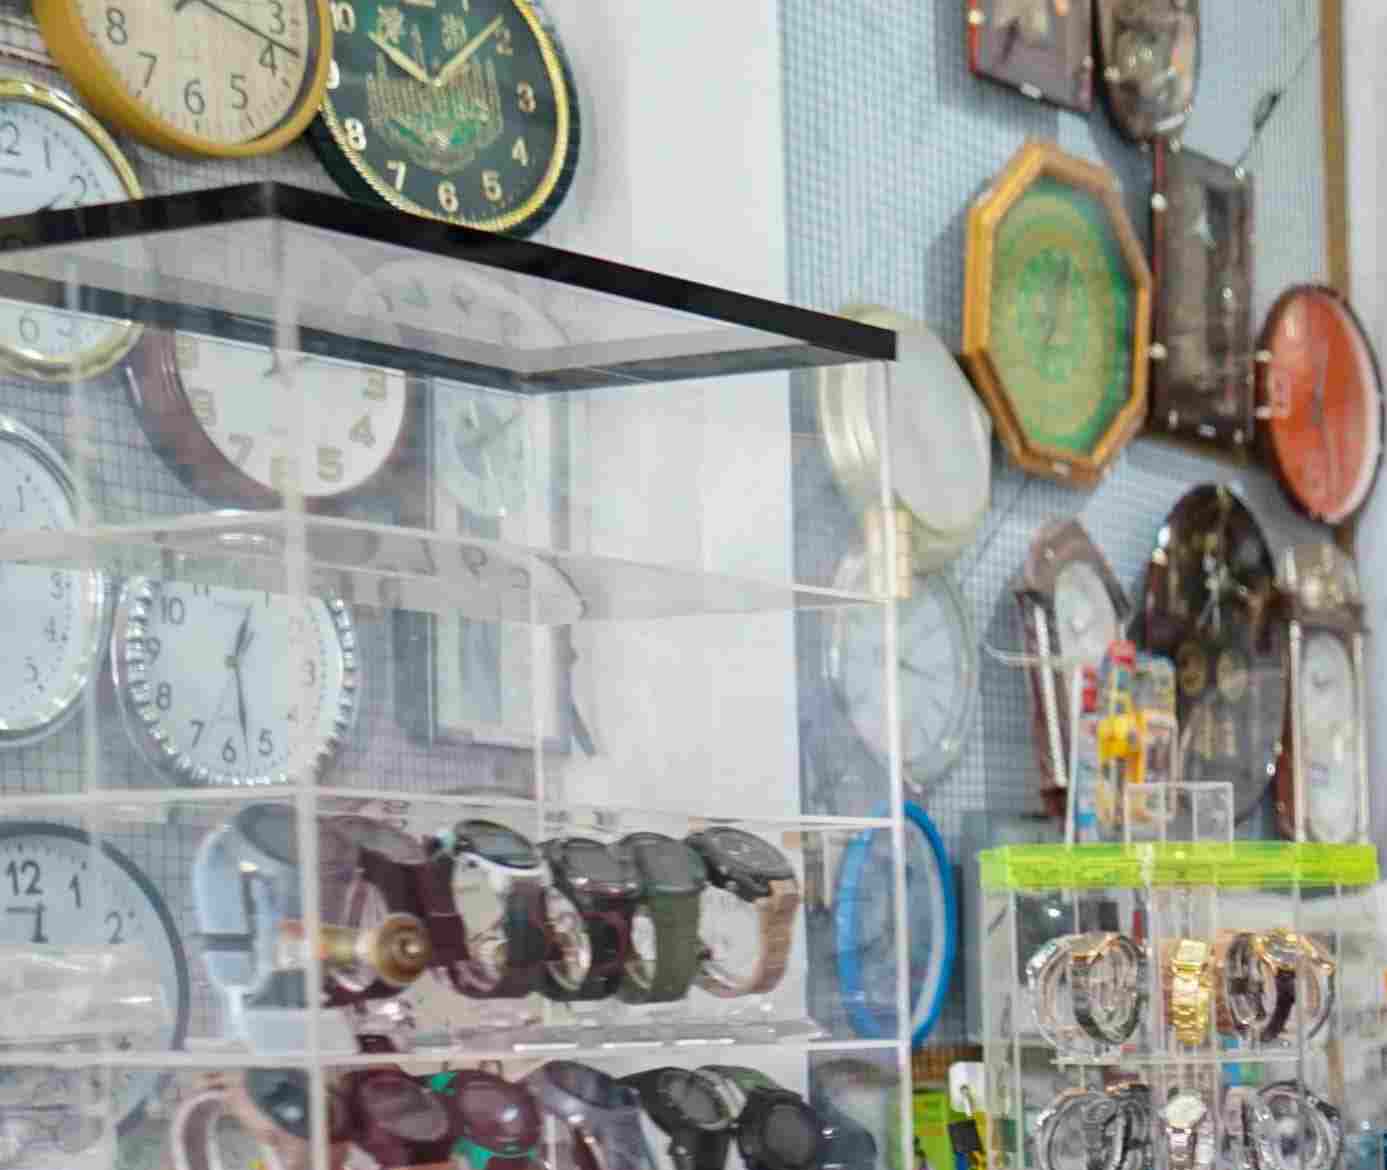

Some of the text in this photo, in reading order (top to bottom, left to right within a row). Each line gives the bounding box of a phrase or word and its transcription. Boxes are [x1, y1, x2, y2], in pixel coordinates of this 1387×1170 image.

[105, 8, 128, 45] 8
[137, 51, 157, 89] 7
[259, 43, 279, 77] 4
[183, 79, 206, 114] 6
[230, 74, 248, 110] 5
[517, 81, 535, 112] 3
[345, 118, 367, 151] 8
[512, 137, 528, 166] 4
[387, 161, 406, 190] 7
[482, 169, 502, 200] 5
[437, 180, 458, 212] 6
[228, 434, 254, 467] 7
[160, 596, 186, 626] 10
[156, 682, 173, 712] 8
[190, 721, 206, 749] 7
[222, 738, 238, 764] 6
[258, 729, 274, 758] 5
[5, 859, 44, 896] 12
[69, 874, 83, 909] 1
[104, 911, 125, 945] 2
